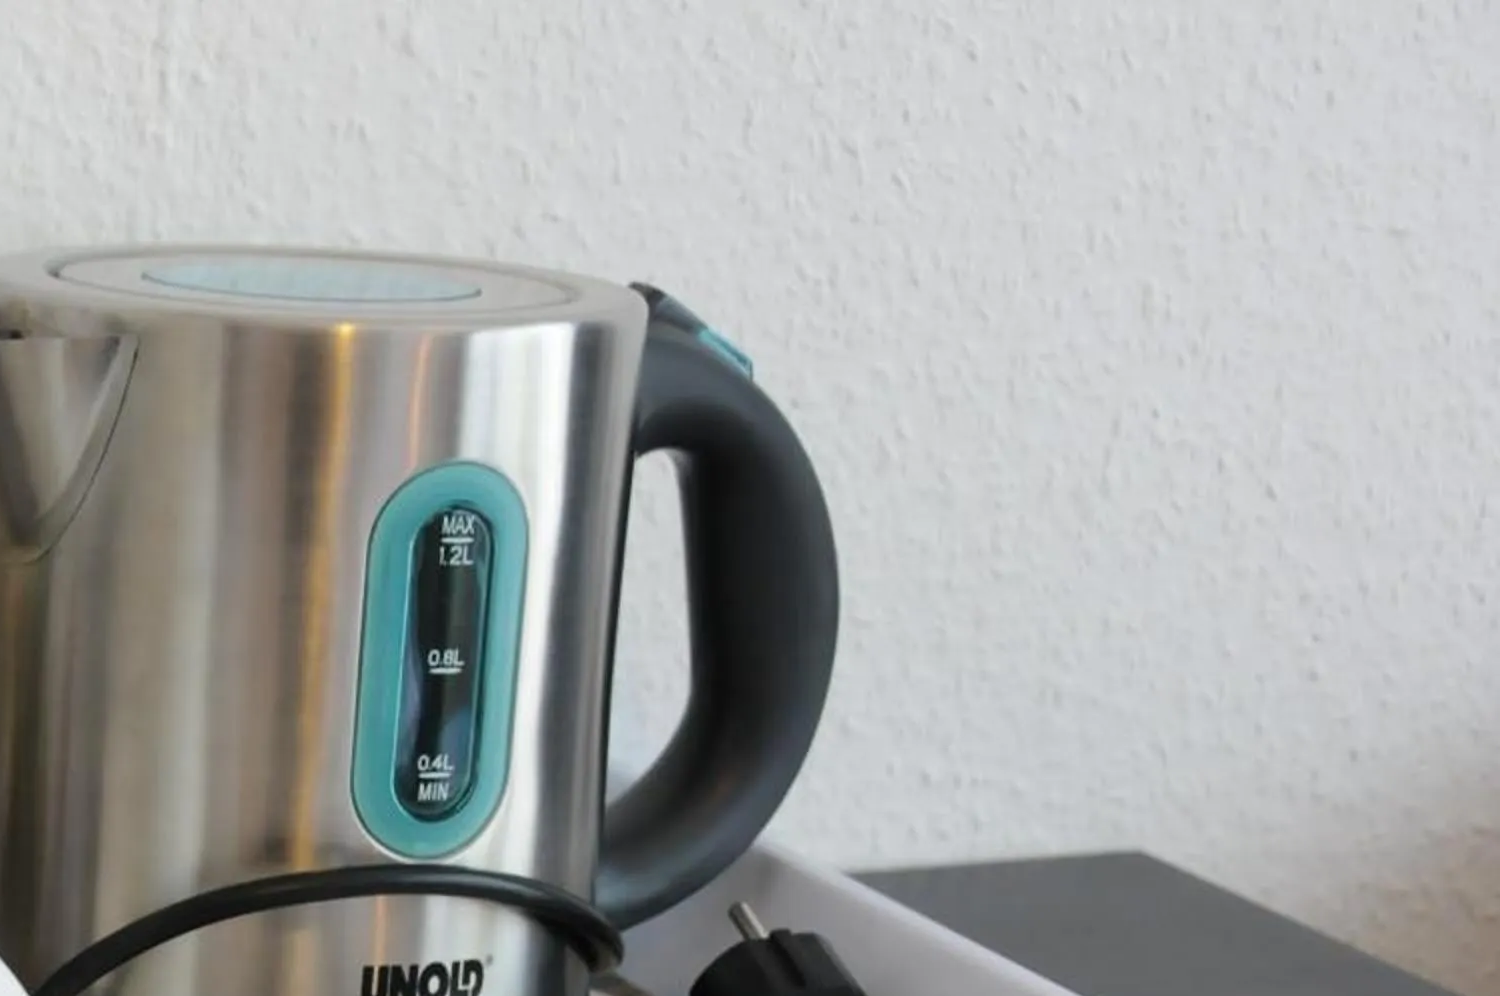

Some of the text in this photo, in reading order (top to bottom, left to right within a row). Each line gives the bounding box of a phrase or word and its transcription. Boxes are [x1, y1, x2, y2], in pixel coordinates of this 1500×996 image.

[441, 515, 475, 534] MAX
[438, 544, 474, 566] 1.2L
[427, 649, 465, 667] 0.8L
[417, 754, 454, 771] 0.4L
[417, 781, 450, 801] MIN
